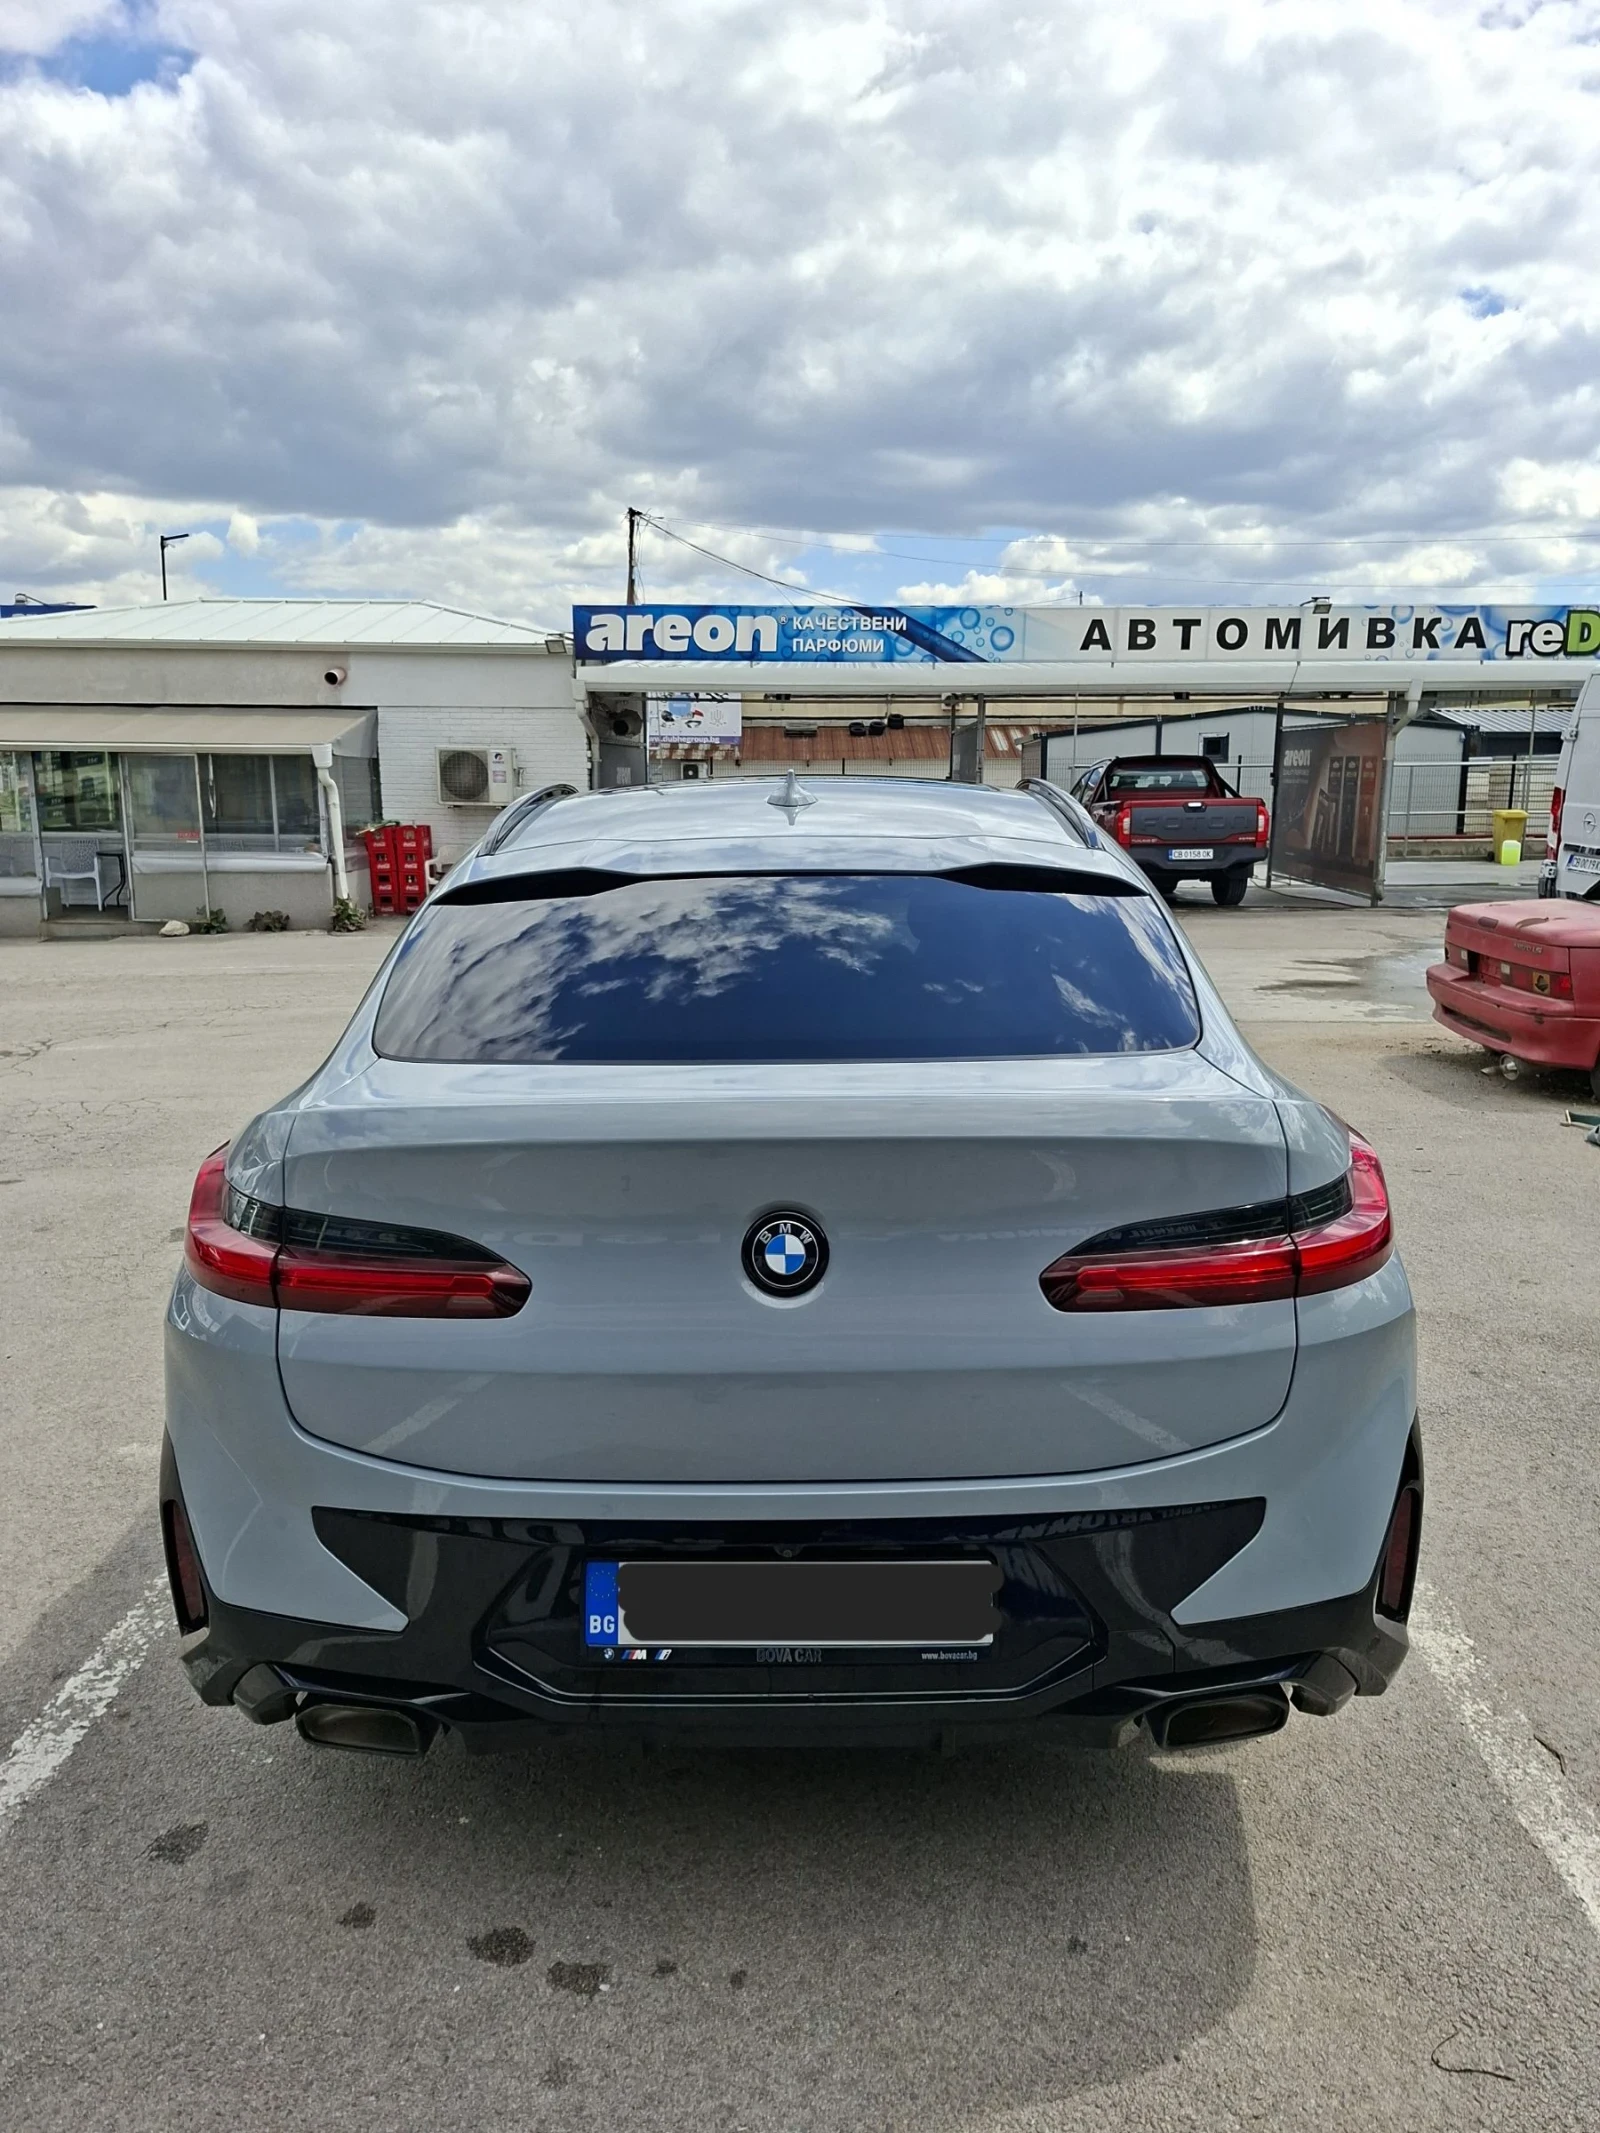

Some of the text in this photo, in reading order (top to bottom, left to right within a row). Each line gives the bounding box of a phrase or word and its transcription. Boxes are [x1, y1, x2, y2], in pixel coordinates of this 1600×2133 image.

[793, 616, 907, 632] КАЧЕСТВЕНИ
[586, 614, 777, 652] areon
[1079, 617, 1487, 651] АВТОМИВКА
[793, 638, 884, 653] ПАРФЮМИ
[759, 1223, 813, 1244] BMW
[589, 1615, 615, 1634] BG
[756, 1648, 822, 1662] BOVA CAR
[921, 1650, 978, 1660] www.bovacar.bg
